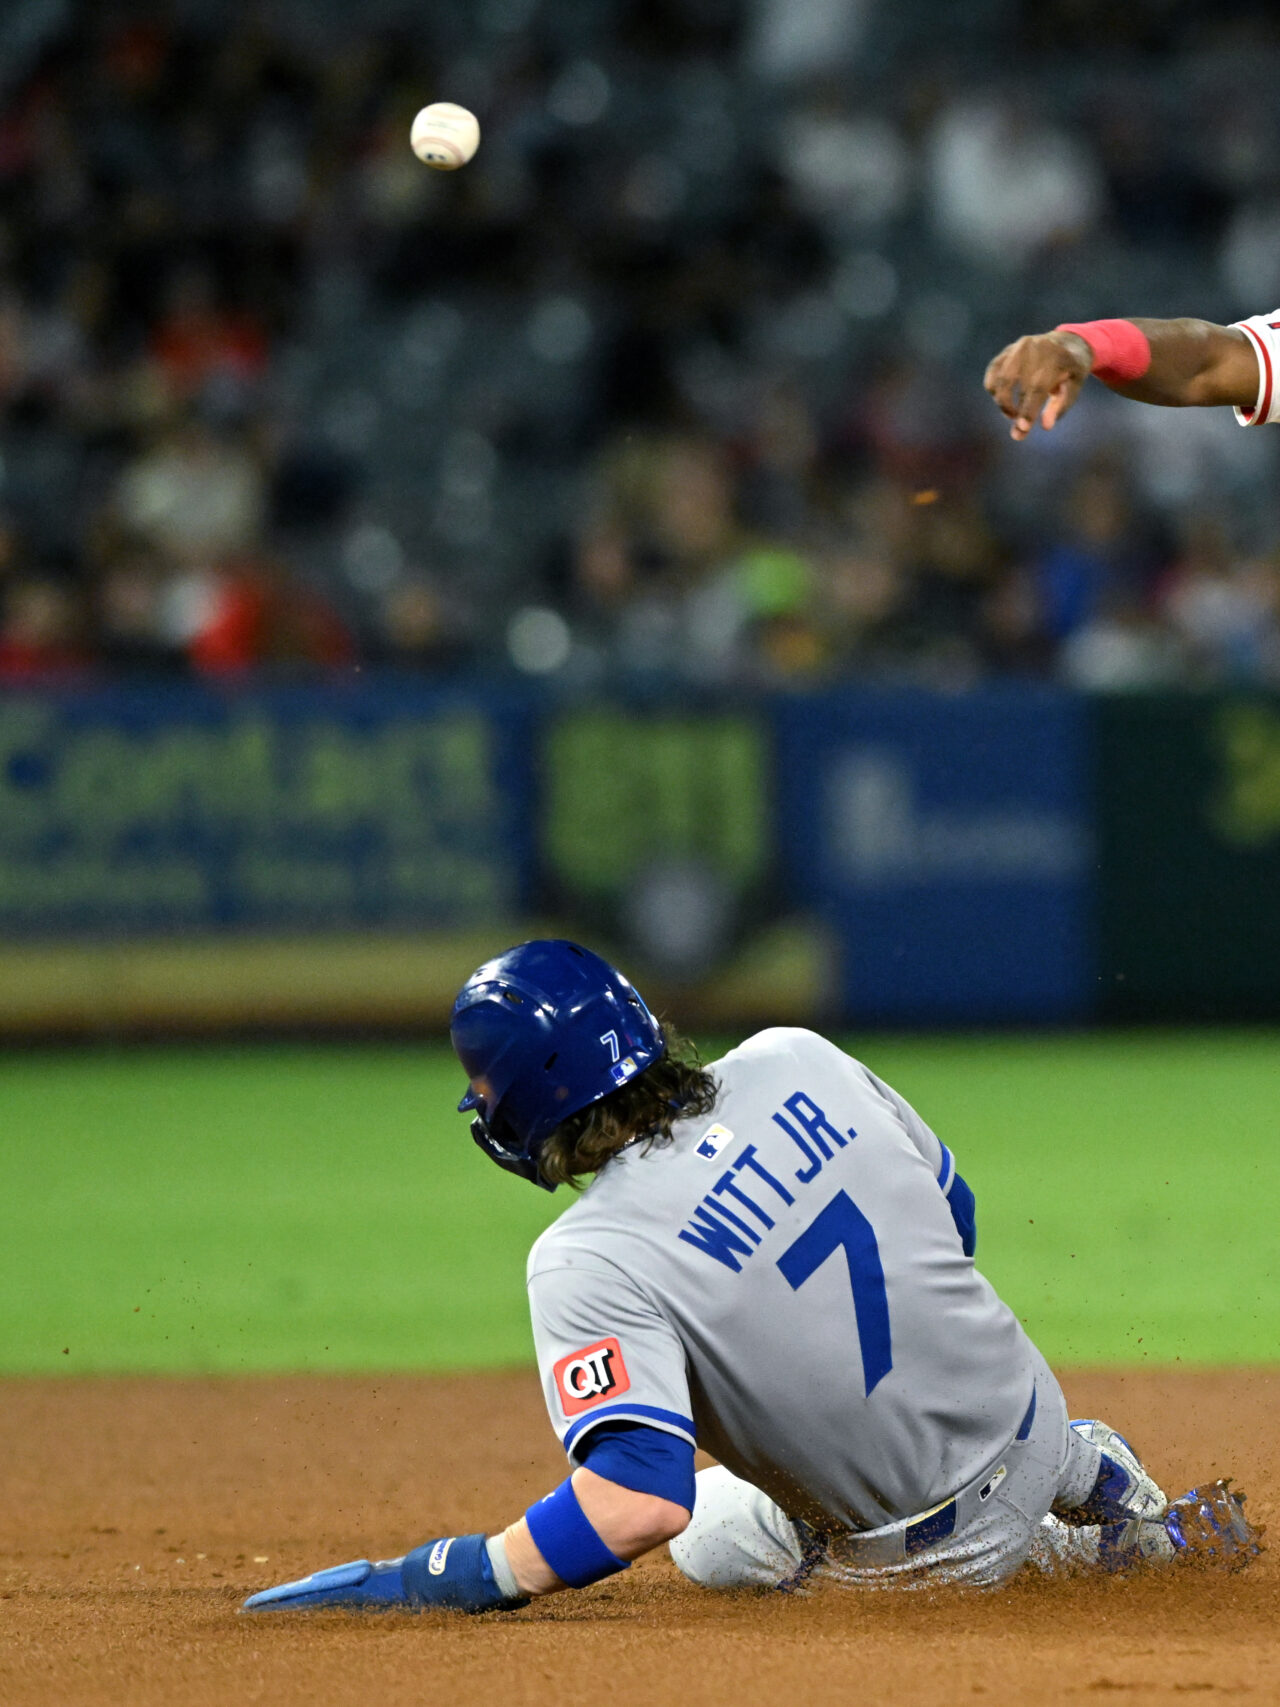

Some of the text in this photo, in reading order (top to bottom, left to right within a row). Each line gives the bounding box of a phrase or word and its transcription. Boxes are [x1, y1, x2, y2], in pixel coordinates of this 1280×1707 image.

[600, 1029, 620, 1063] 7
[677, 1091, 858, 1274] WITT JR.
[775, 1188, 893, 1399] 7
[562, 1347, 616, 1400] QT
